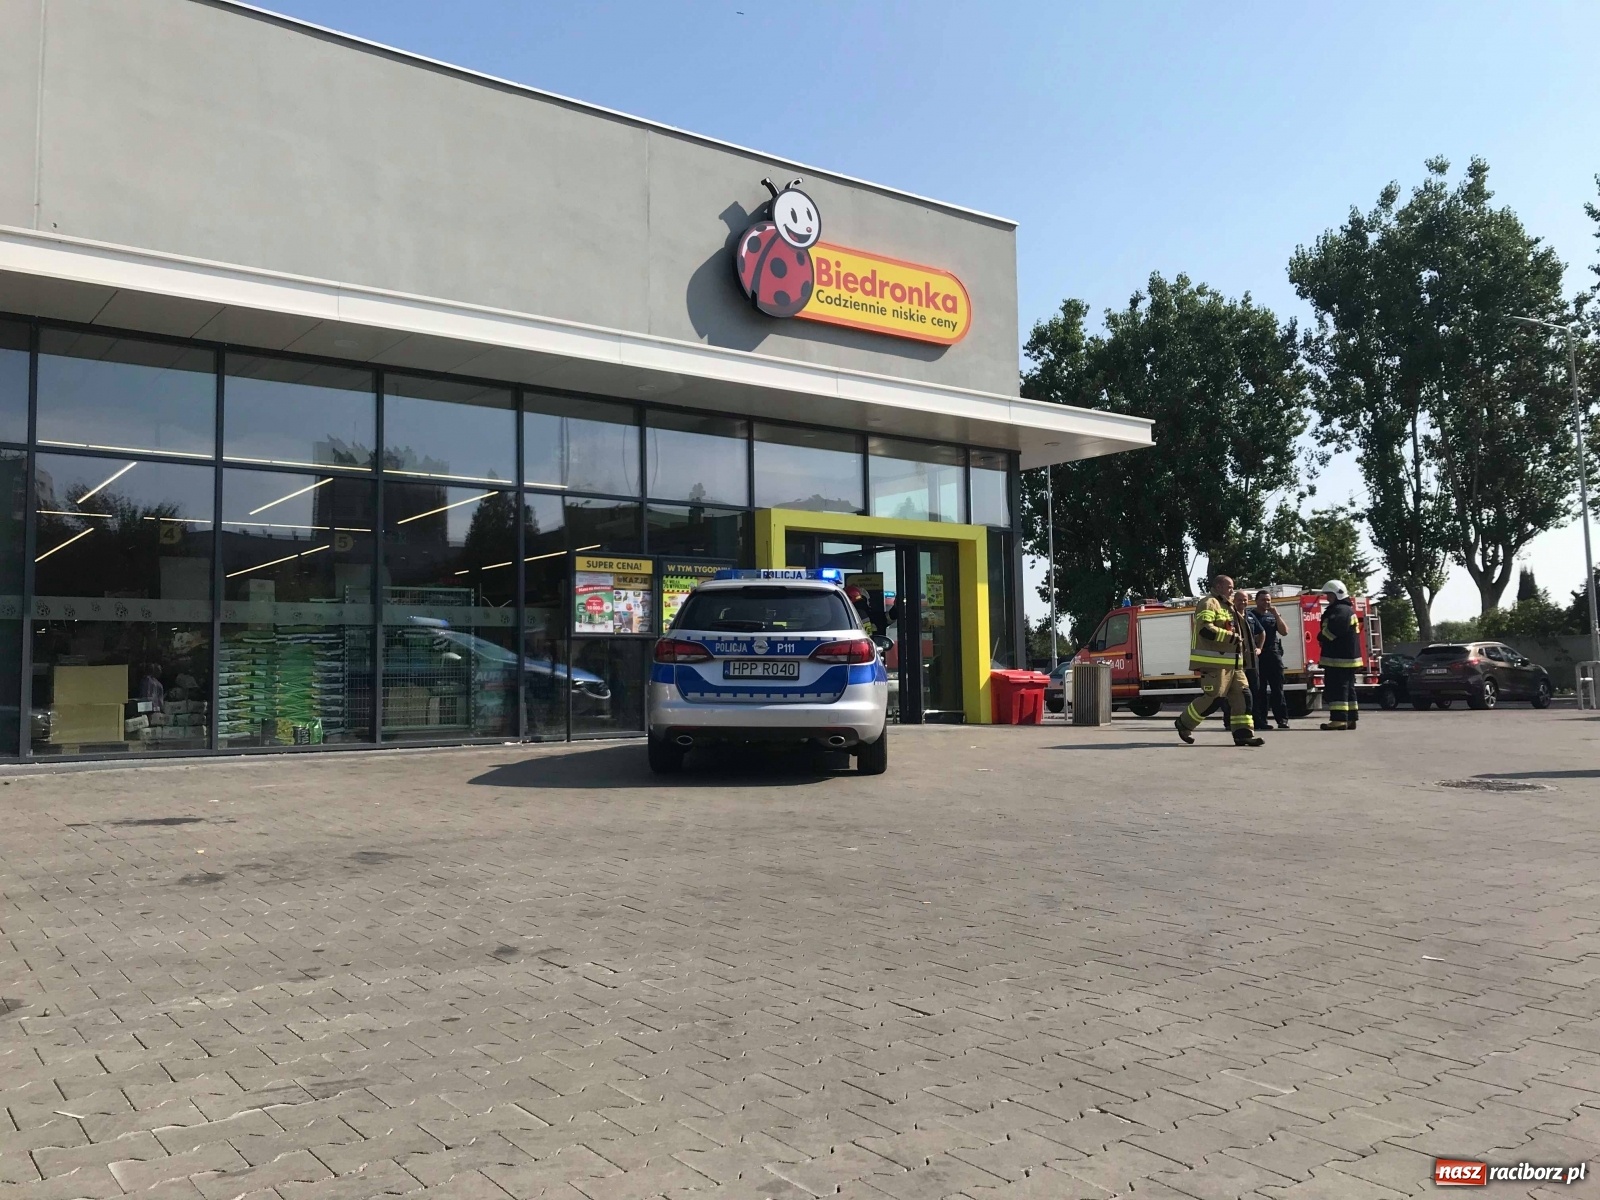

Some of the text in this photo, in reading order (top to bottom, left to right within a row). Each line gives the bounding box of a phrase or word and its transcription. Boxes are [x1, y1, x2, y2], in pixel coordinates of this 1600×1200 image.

[815, 256, 958, 315] Biedronka
[816, 289, 958, 332] Codziennie niskie ceny
[162, 527, 175, 540] 4
[337, 535, 349, 549] 5
[586, 560, 642, 571] SUPER CENA!
[667, 564, 676, 572] W
[677, 565, 692, 573] TYM
[762, 570, 803, 580] POLICJA
[715, 642, 795, 653] POLICJA P111
[732, 662, 796, 676] HPP R040
